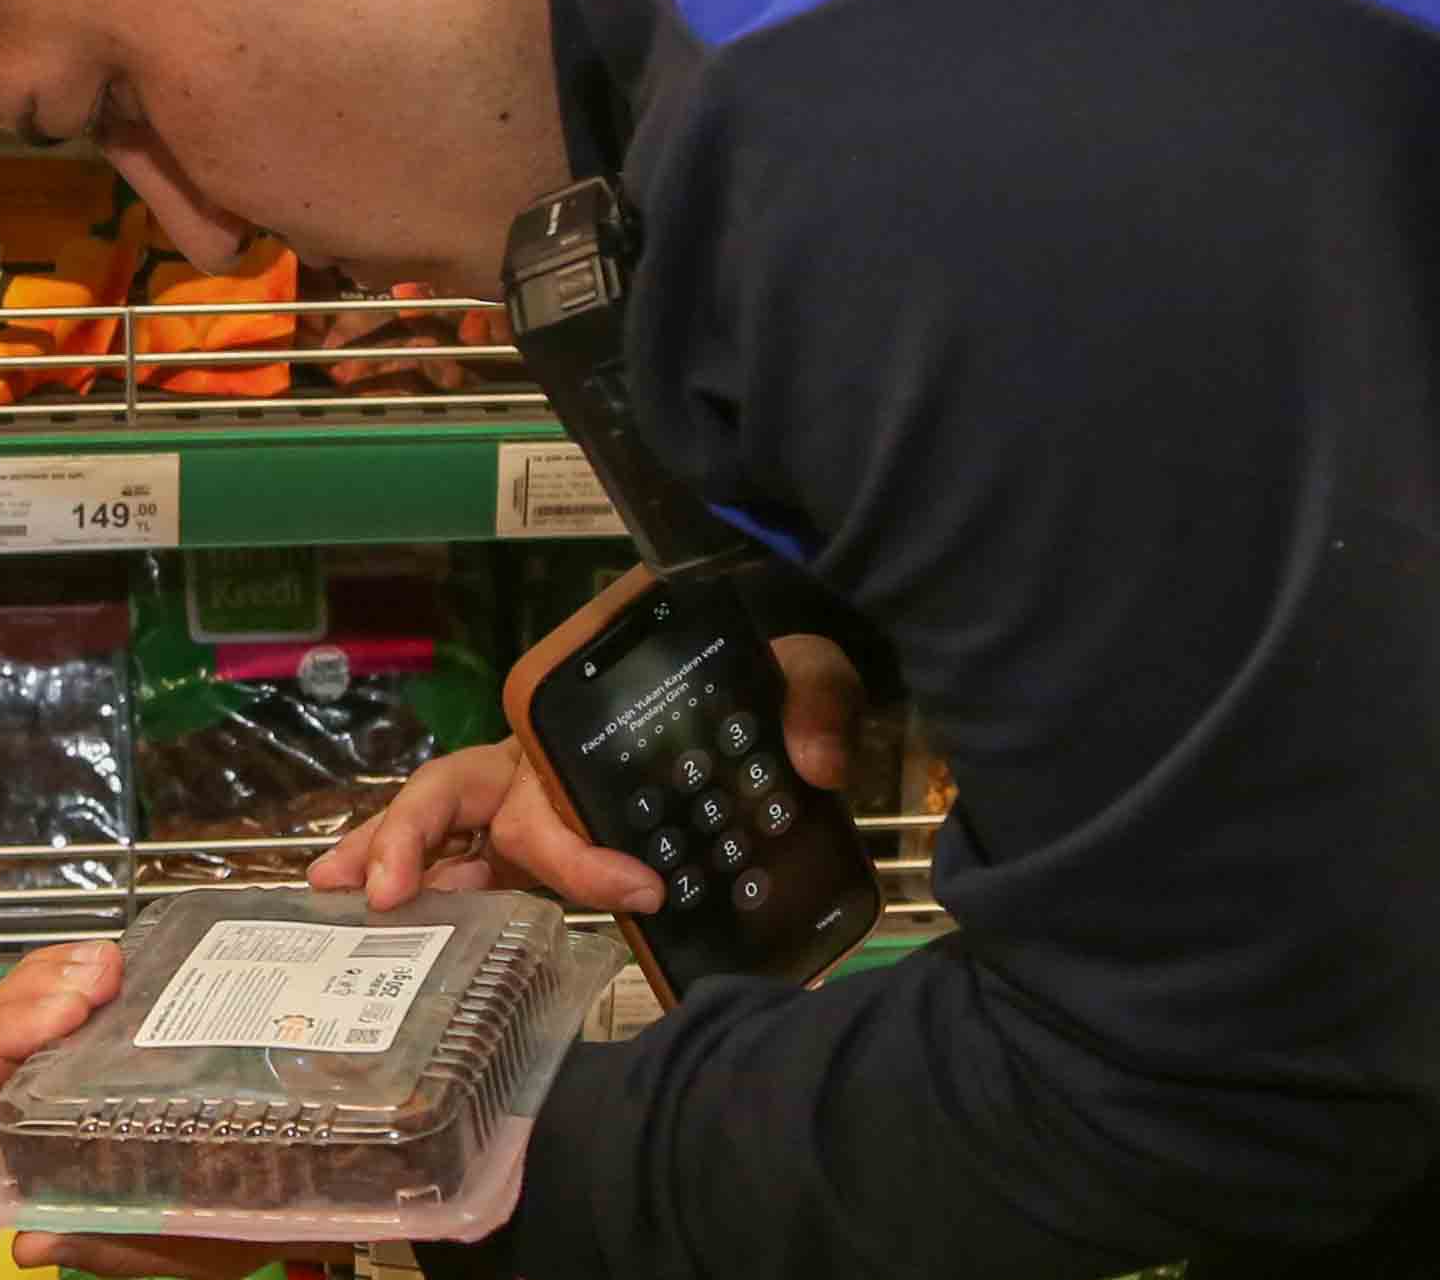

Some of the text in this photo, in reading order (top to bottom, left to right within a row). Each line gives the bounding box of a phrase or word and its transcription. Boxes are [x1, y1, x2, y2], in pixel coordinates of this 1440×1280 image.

[581, 730, 608, 756] Face
[604, 721, 620, 737] ID
[701, 636, 726, 661] veya
[729, 722, 744, 741] 3
[683, 760, 697, 777] 2
[749, 763, 763, 780] 6
[637, 797, 650, 814] 1
[704, 799, 718, 817] 5
[769, 803, 783, 820] 9
[659, 837, 672, 853] 4
[724, 840, 738, 857] 8
[677, 875, 690, 893] 7
[745, 881, 758, 898] 0
